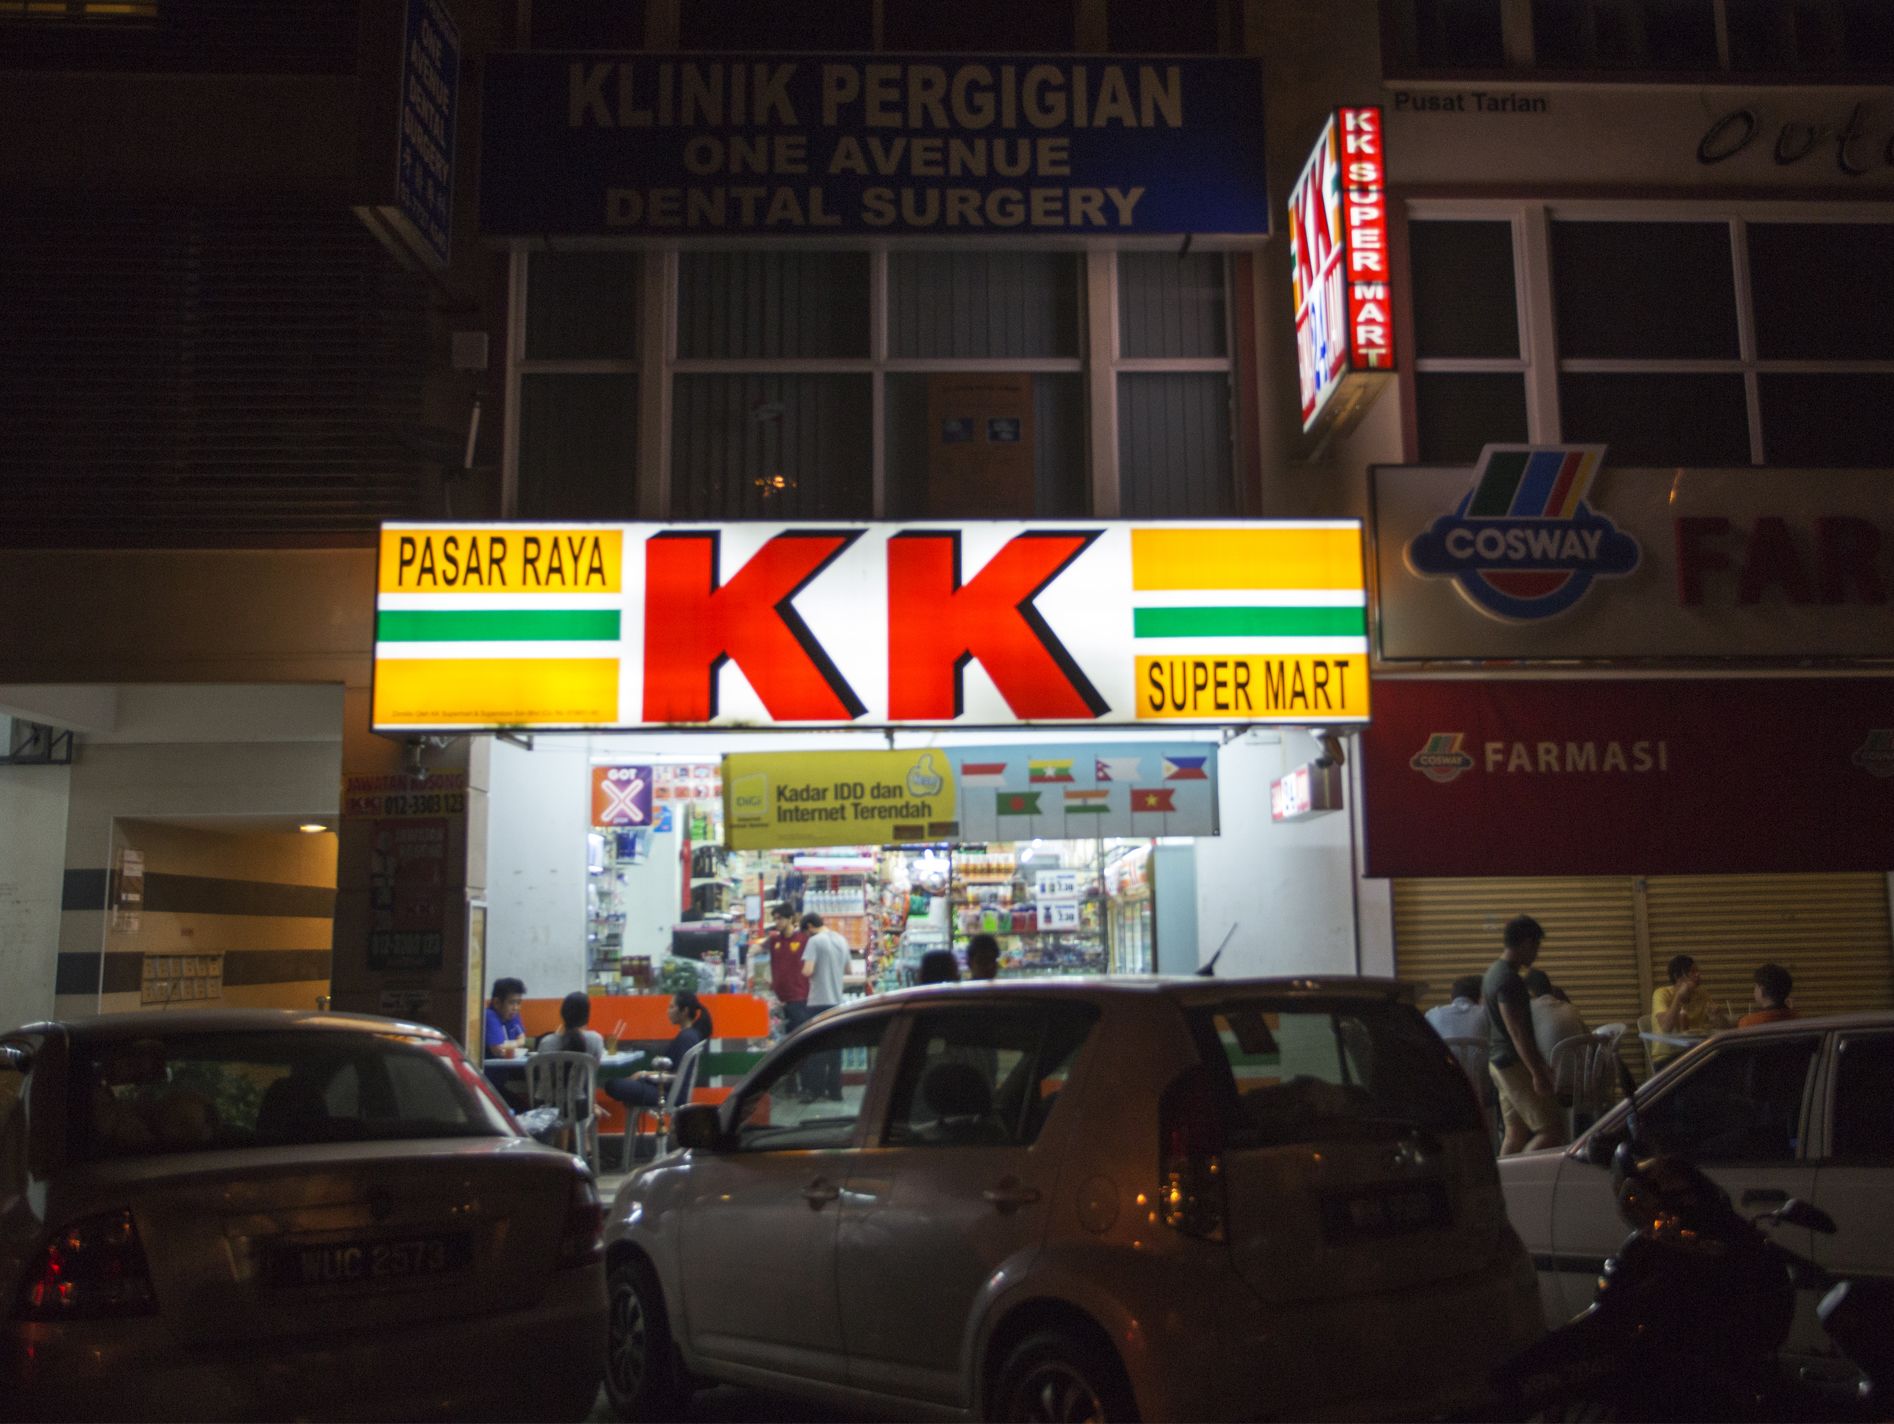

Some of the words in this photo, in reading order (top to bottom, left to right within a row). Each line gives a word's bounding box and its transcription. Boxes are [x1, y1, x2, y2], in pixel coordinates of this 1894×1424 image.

[566, 62, 802, 127] KLINIK
[822, 64, 1184, 129] PERGIGIAN
[1394, 92, 1465, 112] Pusat
[1471, 93, 1548, 113] Tarian
[683, 135, 808, 177] ONE
[828, 136, 1072, 177] AVENUE
[605, 186, 842, 228] DENTAL
[861, 186, 1146, 228] SURGERY
[1348, 162, 1383, 273] SUPER
[1354, 284, 1388, 368] MART
[398, 536, 509, 589] PASAR
[521, 535, 606, 588] RAYA
[1445, 527, 1603, 561] COSWAY
[642, 527, 1112, 724] KK
[1147, 659, 1252, 713] SUPER
[1264, 659, 1351, 711] MART
[608, 767, 638, 780] GOT
[1484, 741, 1669, 775] FARMASI
[776, 784, 829, 802] Kadar
[834, 781, 865, 800] IDD
[870, 782, 904, 799] dan
[776, 804, 847, 823] Internet
[850, 800, 932, 820] Terendah
